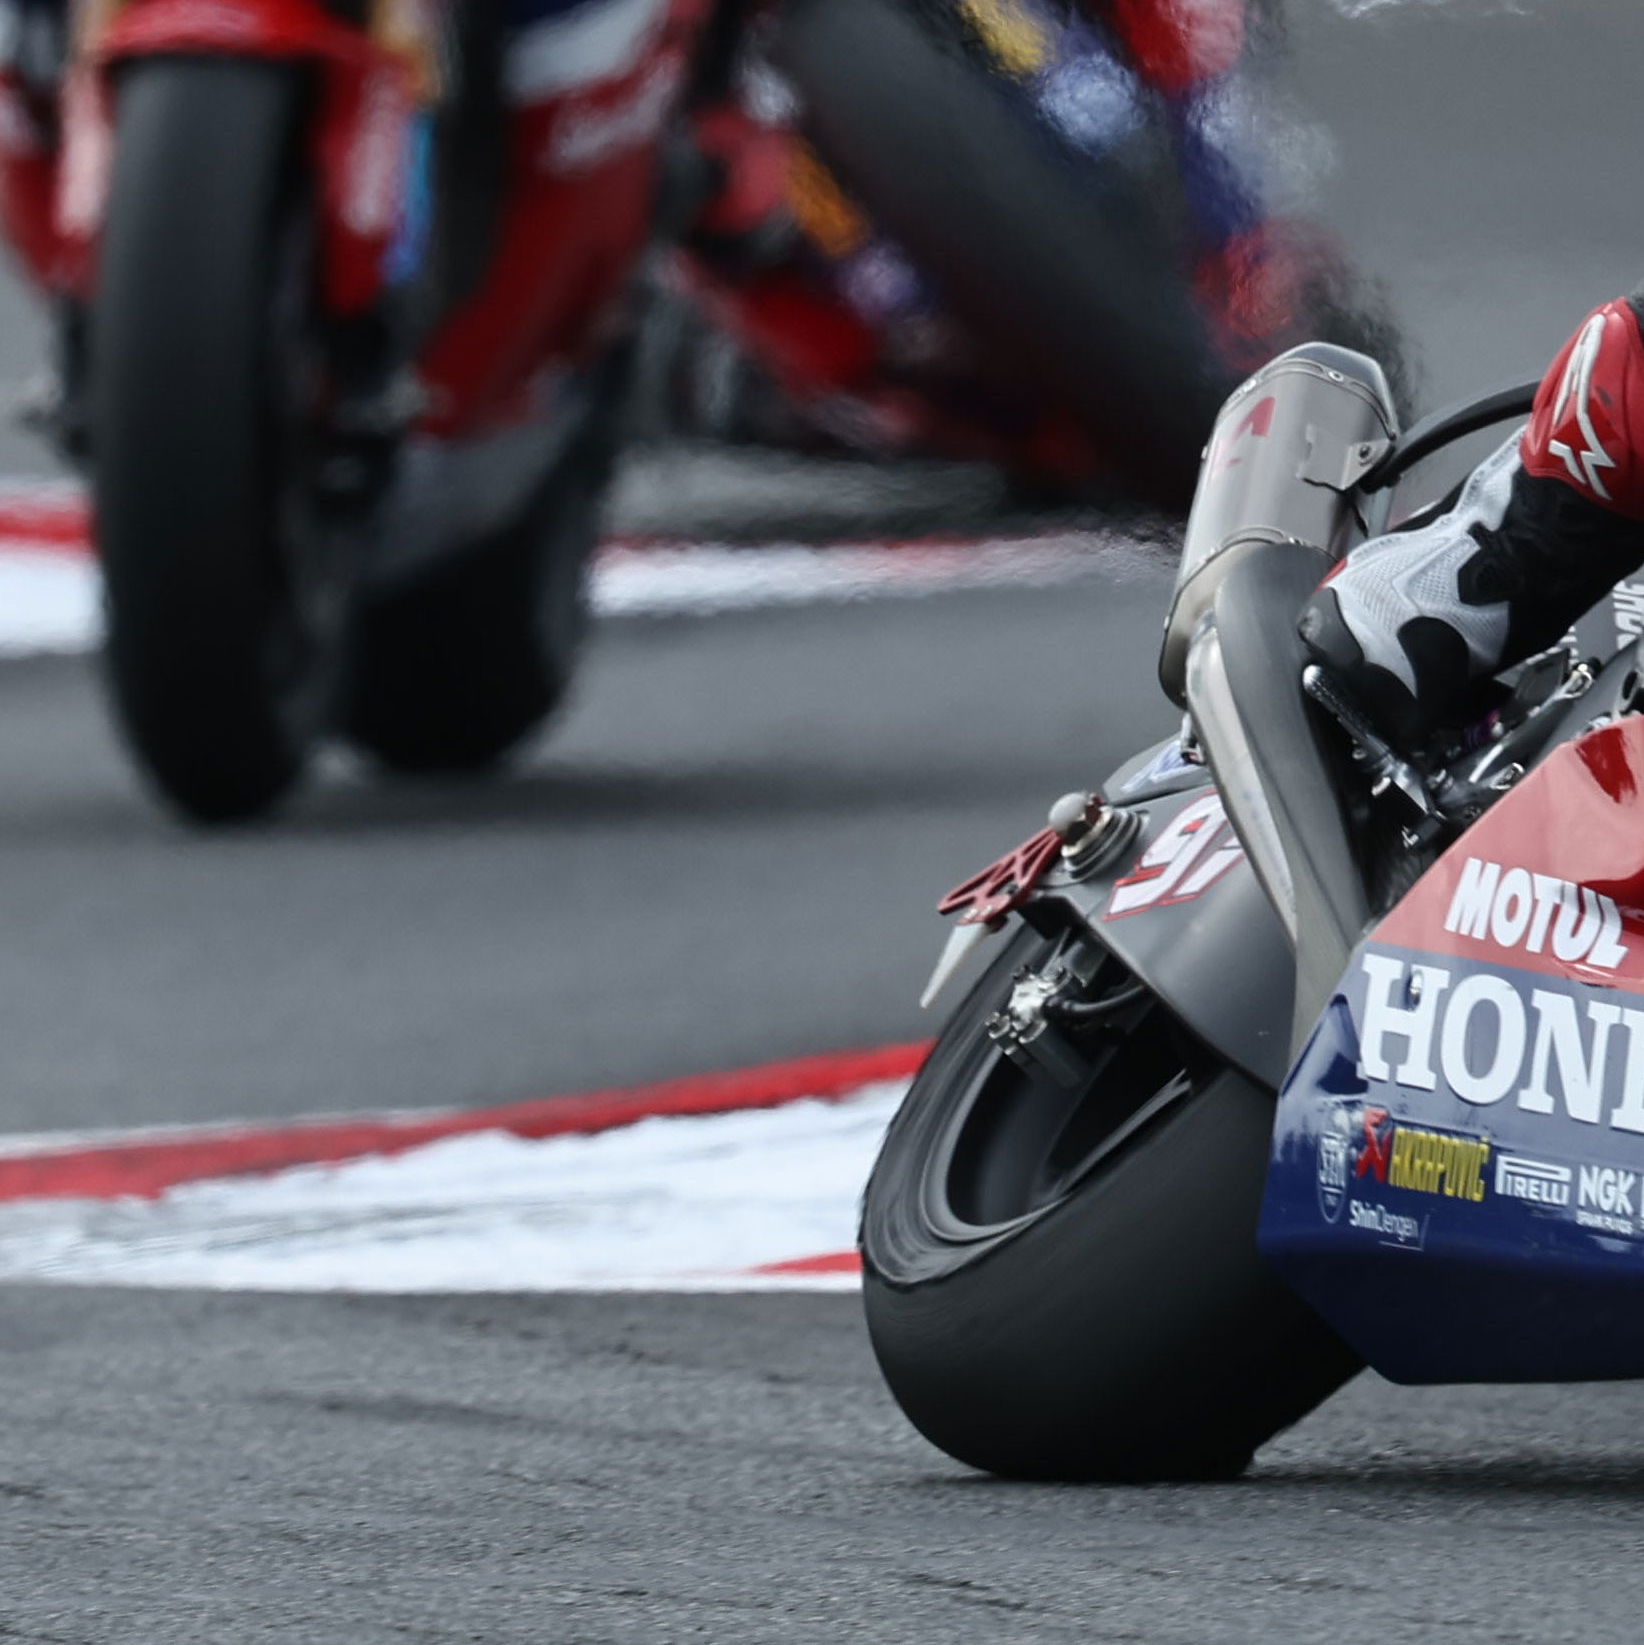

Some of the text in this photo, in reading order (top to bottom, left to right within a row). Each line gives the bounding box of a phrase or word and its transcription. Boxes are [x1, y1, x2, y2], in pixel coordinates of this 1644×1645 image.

[1445, 857, 1628, 969] MOTUL
[1495, 1155, 1572, 1205] PIRELLI
[1578, 1165, 1634, 1216] NGK
